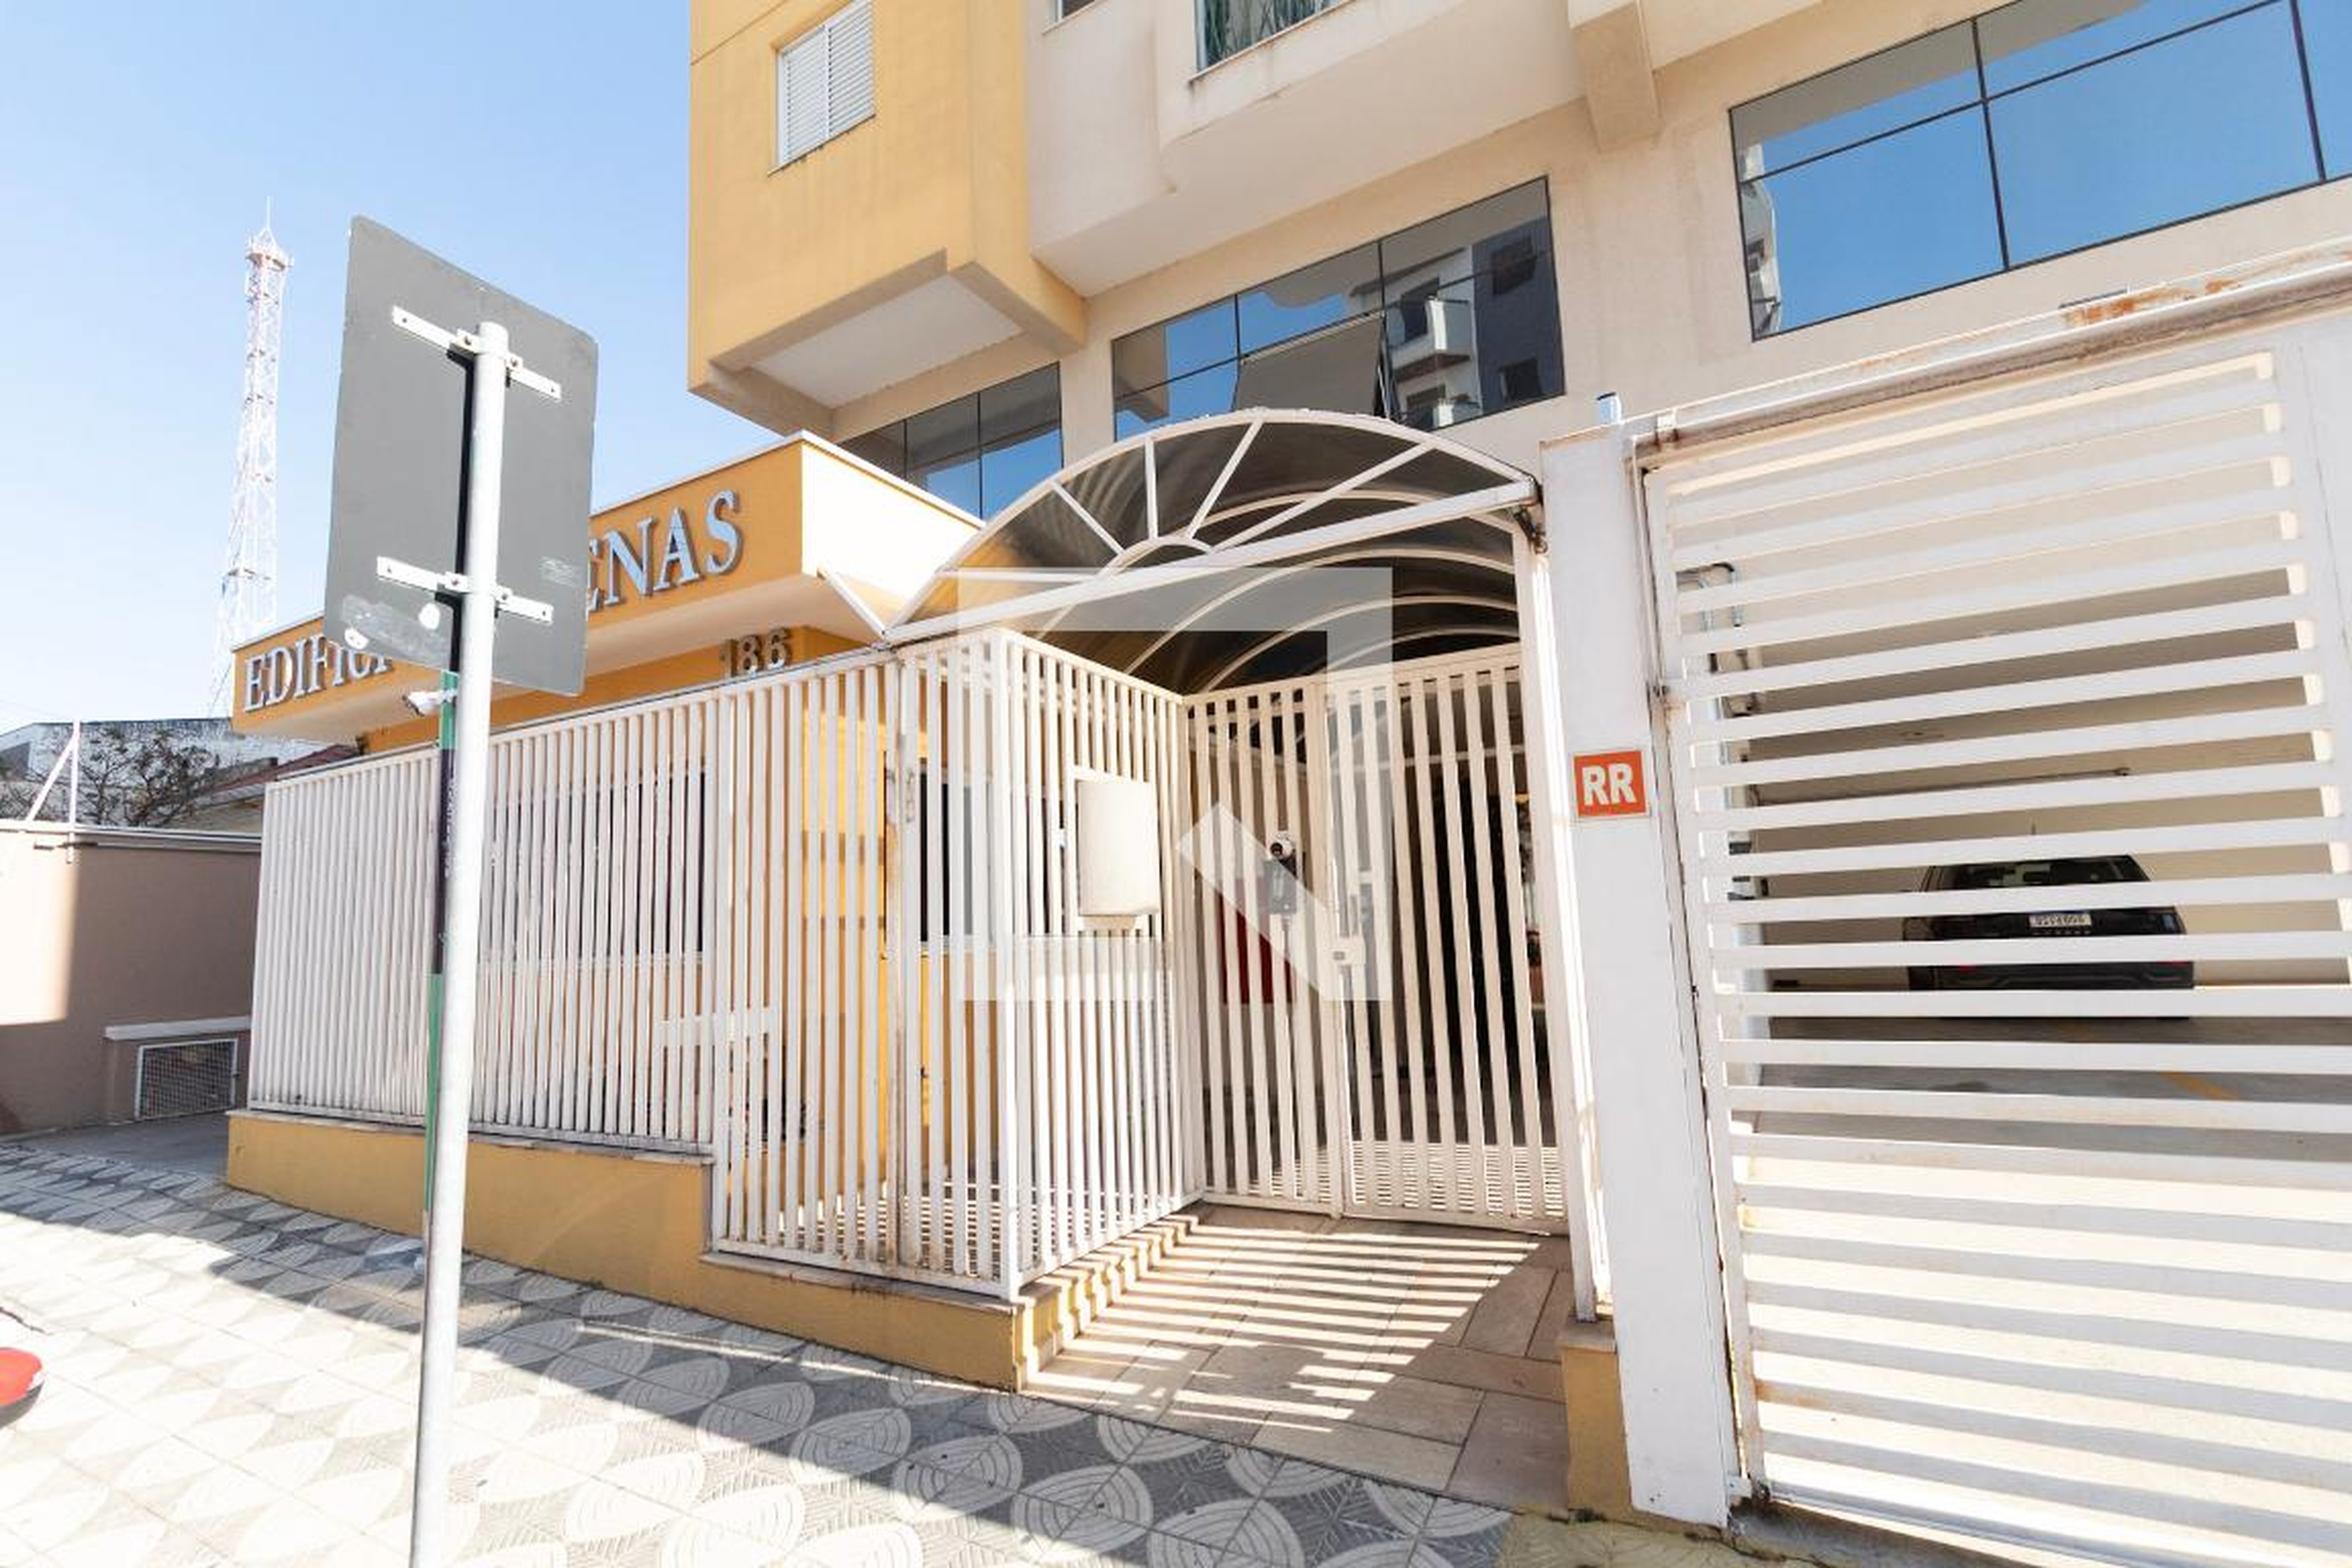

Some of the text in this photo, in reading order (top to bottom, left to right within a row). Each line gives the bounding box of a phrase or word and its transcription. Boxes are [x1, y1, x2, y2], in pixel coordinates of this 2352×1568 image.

[243, 633, 391, 712] EDIFIC
[719, 628, 792, 677] 186
[1581, 763, 1638, 807] RR
